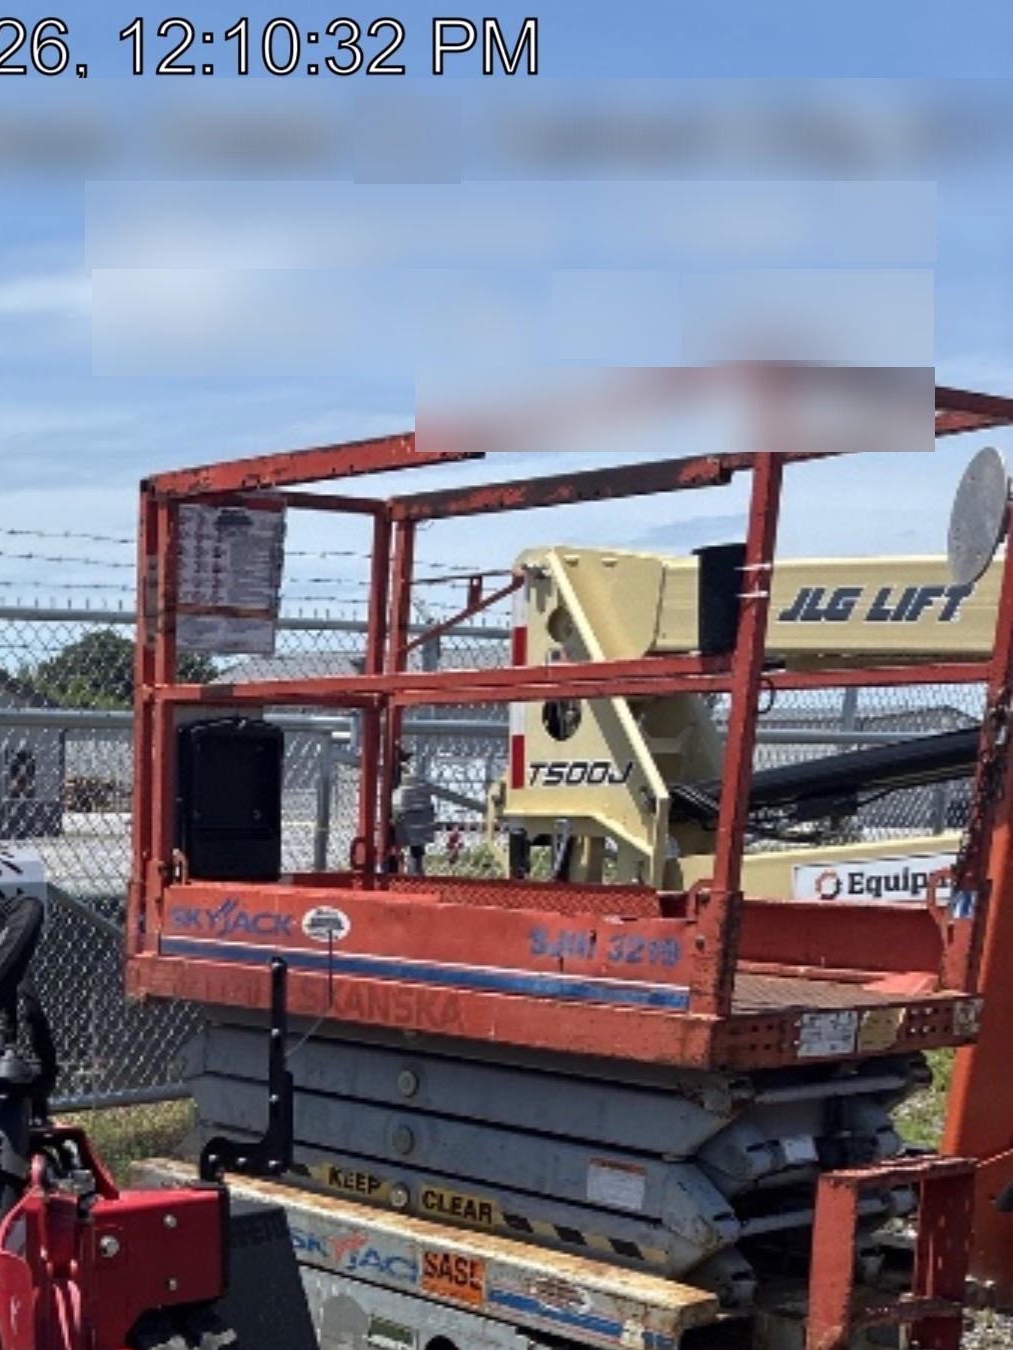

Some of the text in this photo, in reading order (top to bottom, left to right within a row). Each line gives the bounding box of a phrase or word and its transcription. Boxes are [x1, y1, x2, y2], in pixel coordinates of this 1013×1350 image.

[776, 582, 977, 623] JLG LIFT
[529, 760, 634, 787] T500J
[328, 1165, 494, 1225] KEEP CLEAR
